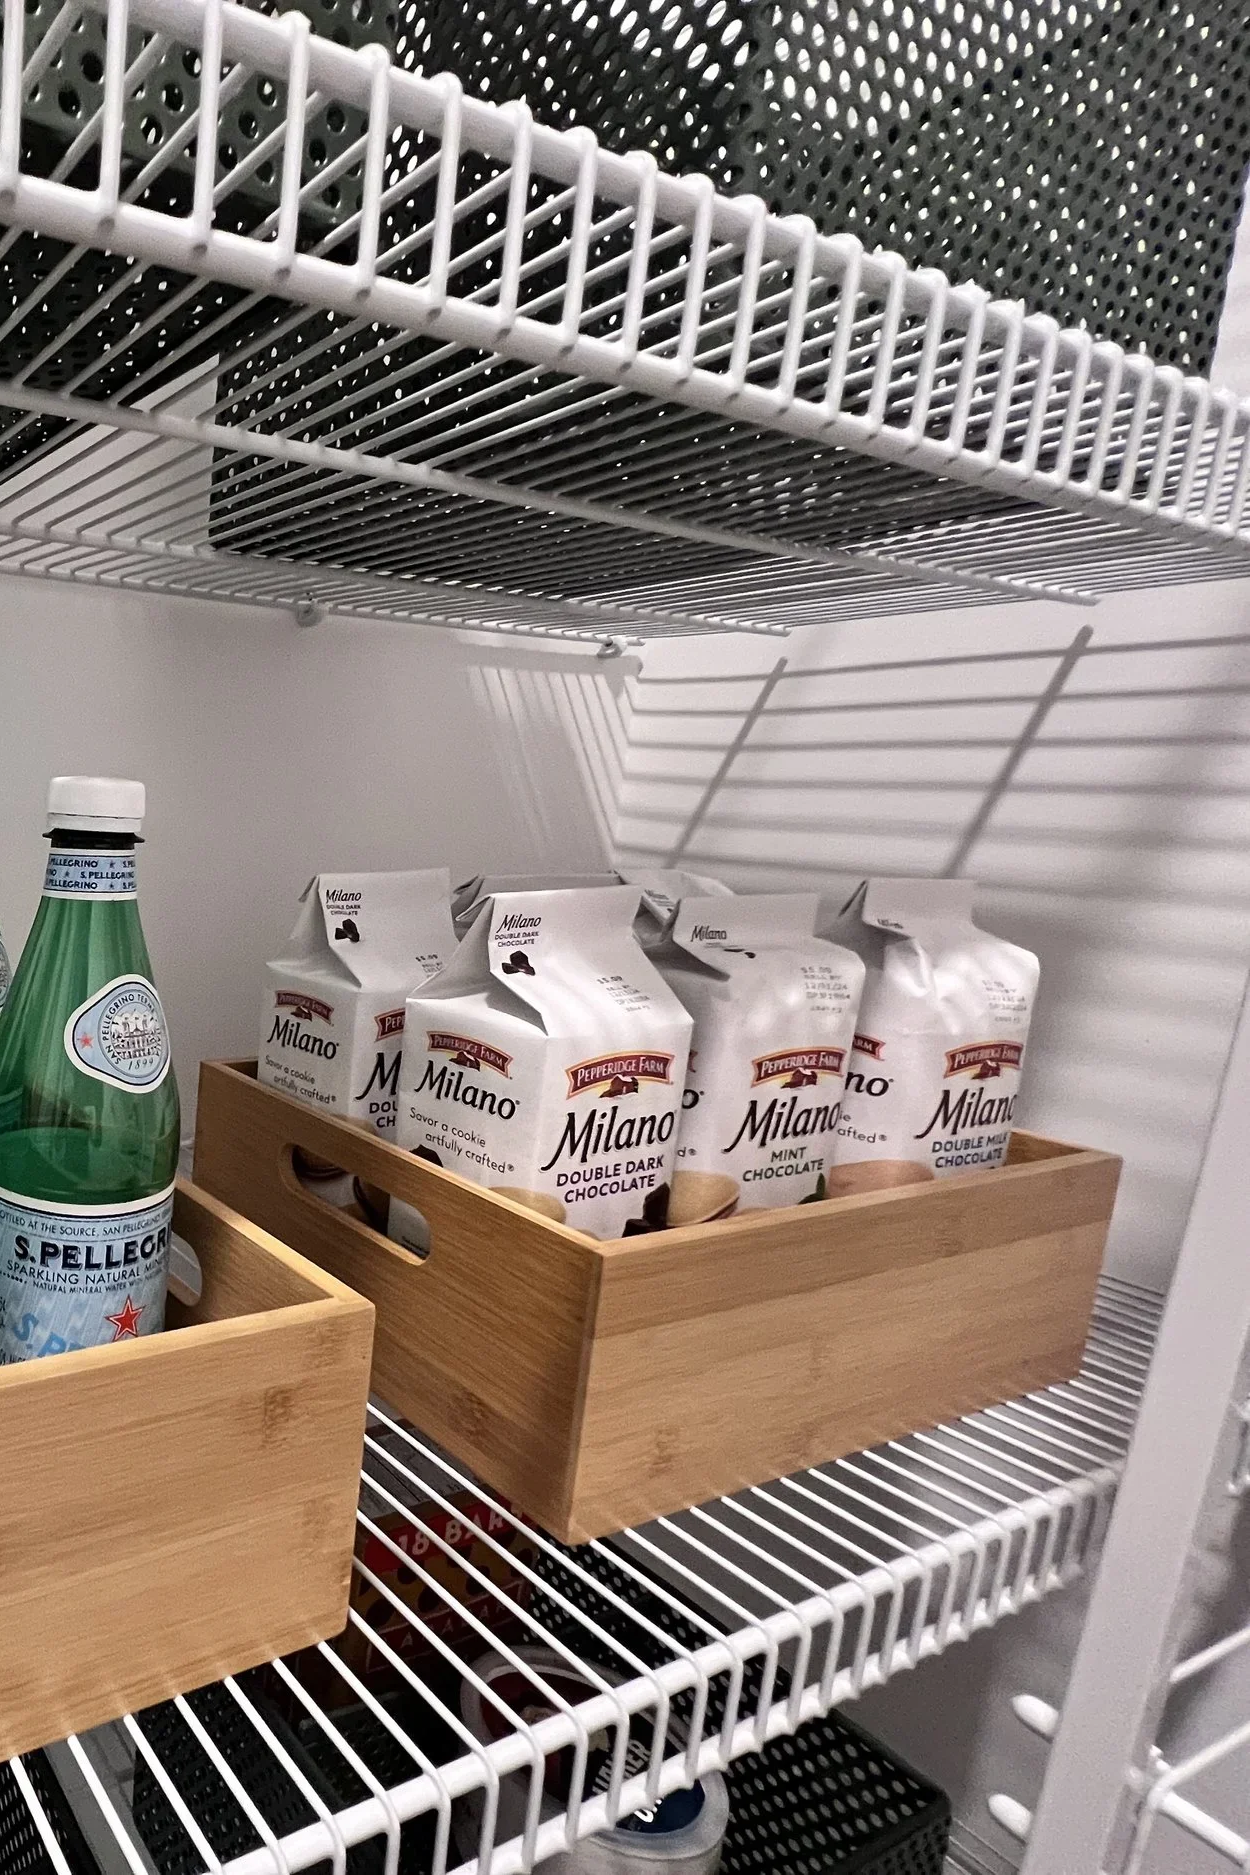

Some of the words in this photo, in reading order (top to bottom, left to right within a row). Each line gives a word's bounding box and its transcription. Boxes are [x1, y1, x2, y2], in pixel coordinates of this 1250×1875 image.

[326, 889, 362, 904] Milano
[496, 913, 542, 934] Milano
[690, 925, 728, 943] Milano
[101, 993, 135, 1042] PELLEGRINO
[266, 1014, 337, 1060] Milano
[576, 1058, 638, 1087] PEPPERIDGE
[638, 1056, 664, 1074] FARM
[760, 1053, 819, 1078] PEPPERIDGE
[413, 1059, 517, 1120] Milano
[410, 1106, 439, 1128] Savor
[441, 1122, 449, 1132] a
[451, 1125, 486, 1148] cookie
[721, 1095, 841, 1154] Milano
[425, 1131, 463, 1157] artfully
[540, 1105, 676, 1172] Milano
[931, 1136, 984, 1154] DOUBLE
[770, 1146, 808, 1163] MINT
[934, 1147, 1005, 1169] CHOCOLATE
[556, 1162, 622, 1187] DOUBLE
[625, 1154, 664, 1175] DARK
[742, 1158, 825, 1183] CHOCOLATE
[564, 1173, 656, 1204] CHOCOLATE
[28, 1220, 38, 1230] AT
[41, 1222, 57, 1234] THE
[103, 1225, 121, 1236] SAN
[6, 1258, 79, 1286] SPARKLING
[85, 1266, 140, 1285] NATURAL
[32, 1279, 67, 1295] NATURAL
